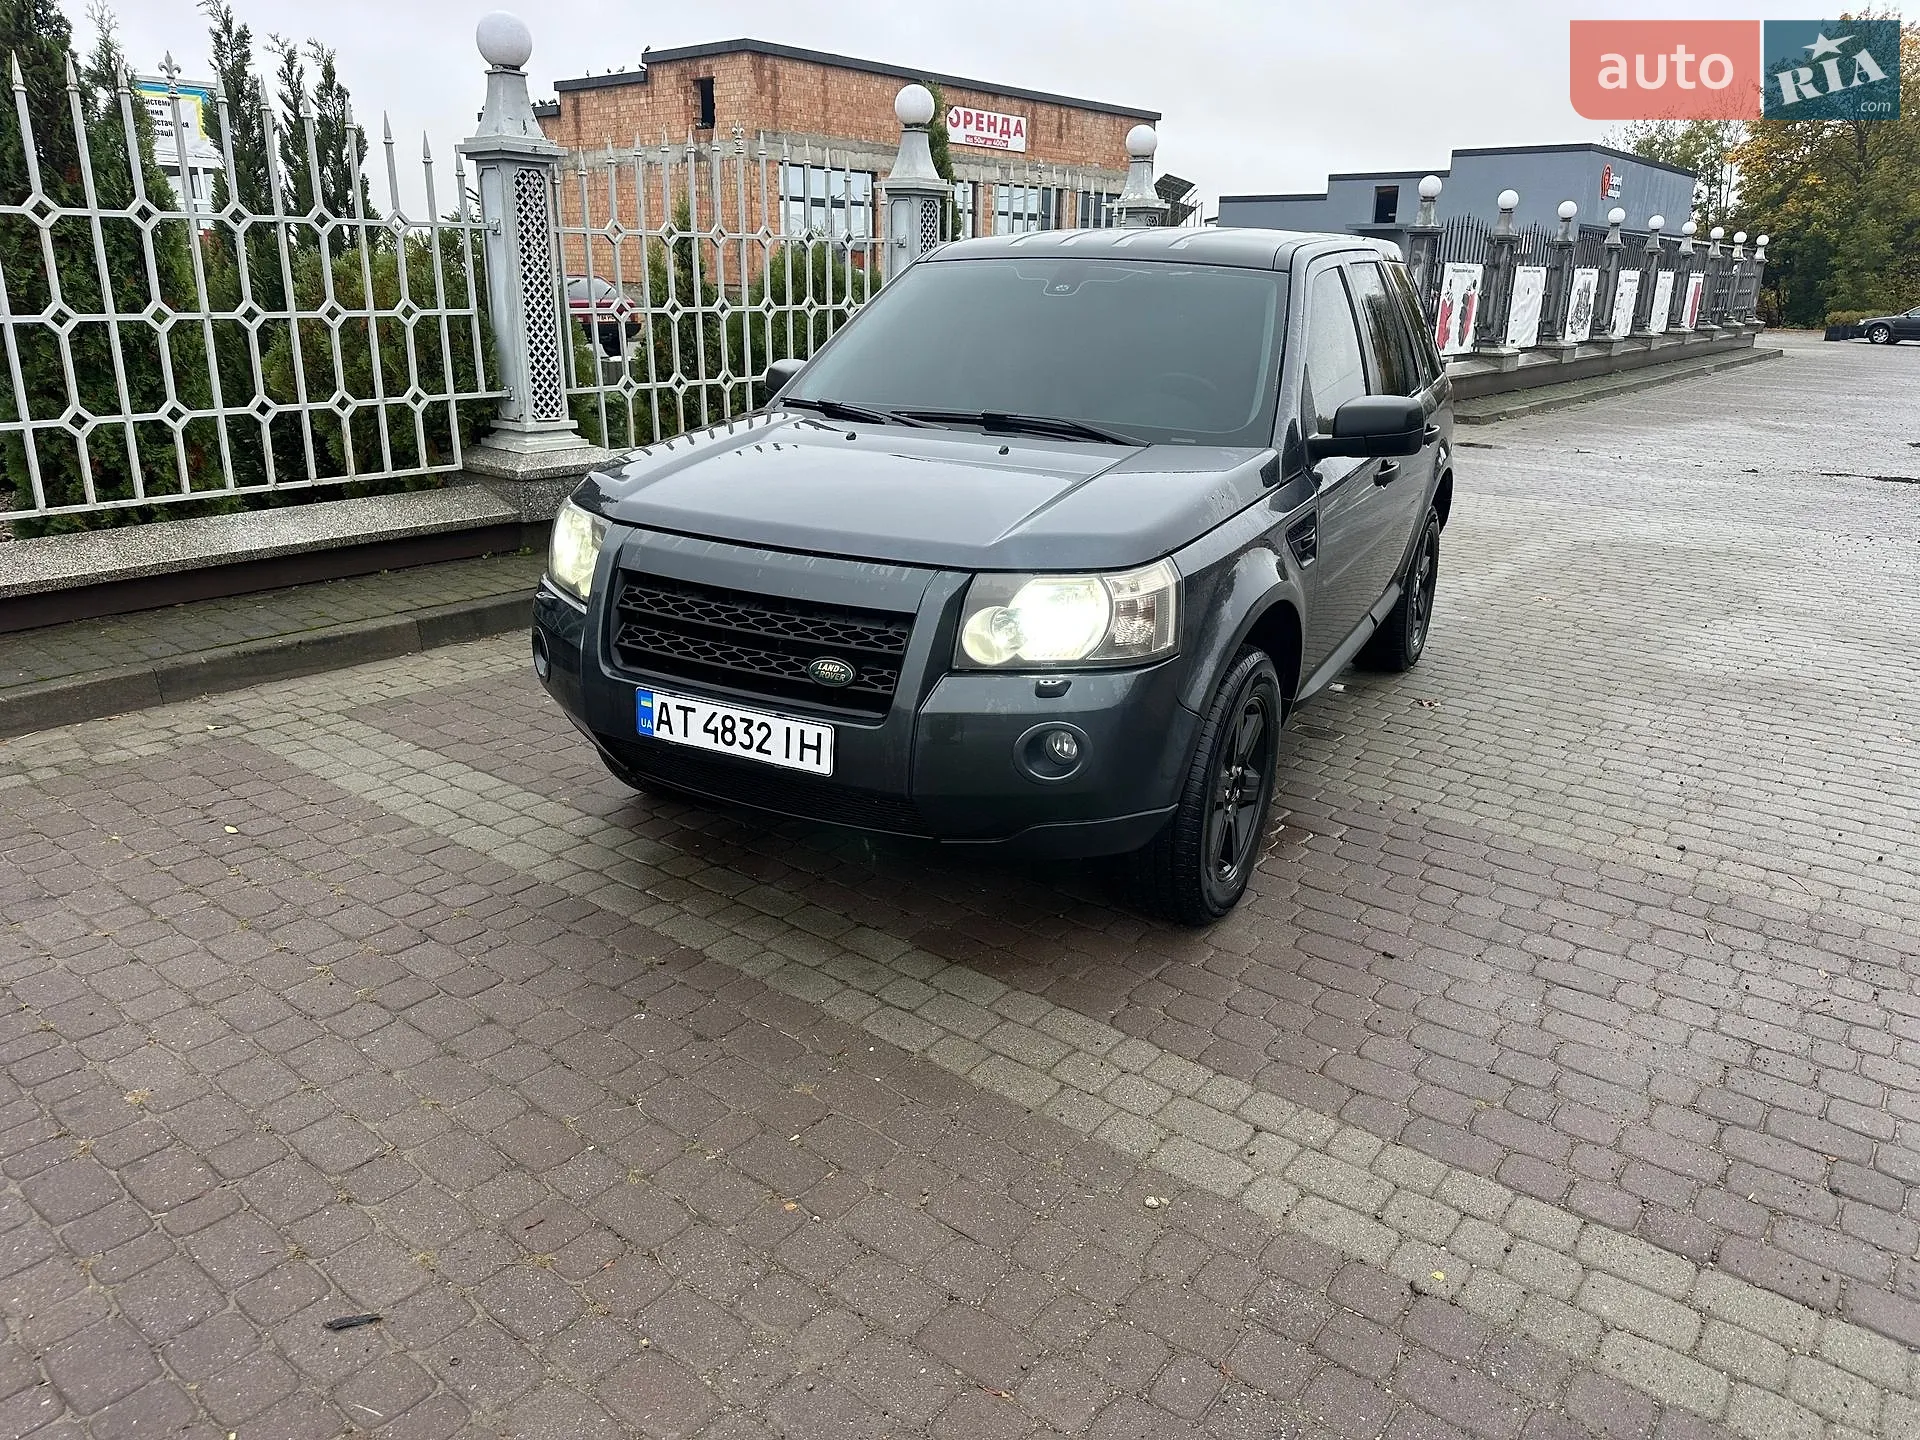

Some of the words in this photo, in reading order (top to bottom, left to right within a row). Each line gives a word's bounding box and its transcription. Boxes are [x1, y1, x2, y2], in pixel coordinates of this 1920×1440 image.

[948, 108, 1024, 139] ОРЕНДА
[818, 662, 840, 673] LAND
[819, 670, 846, 682] ROVER
[640, 717, 653, 730] UA
[655, 701, 697, 738] AT
[702, 711, 772, 756] 4832
[784, 726, 822, 766] IH
